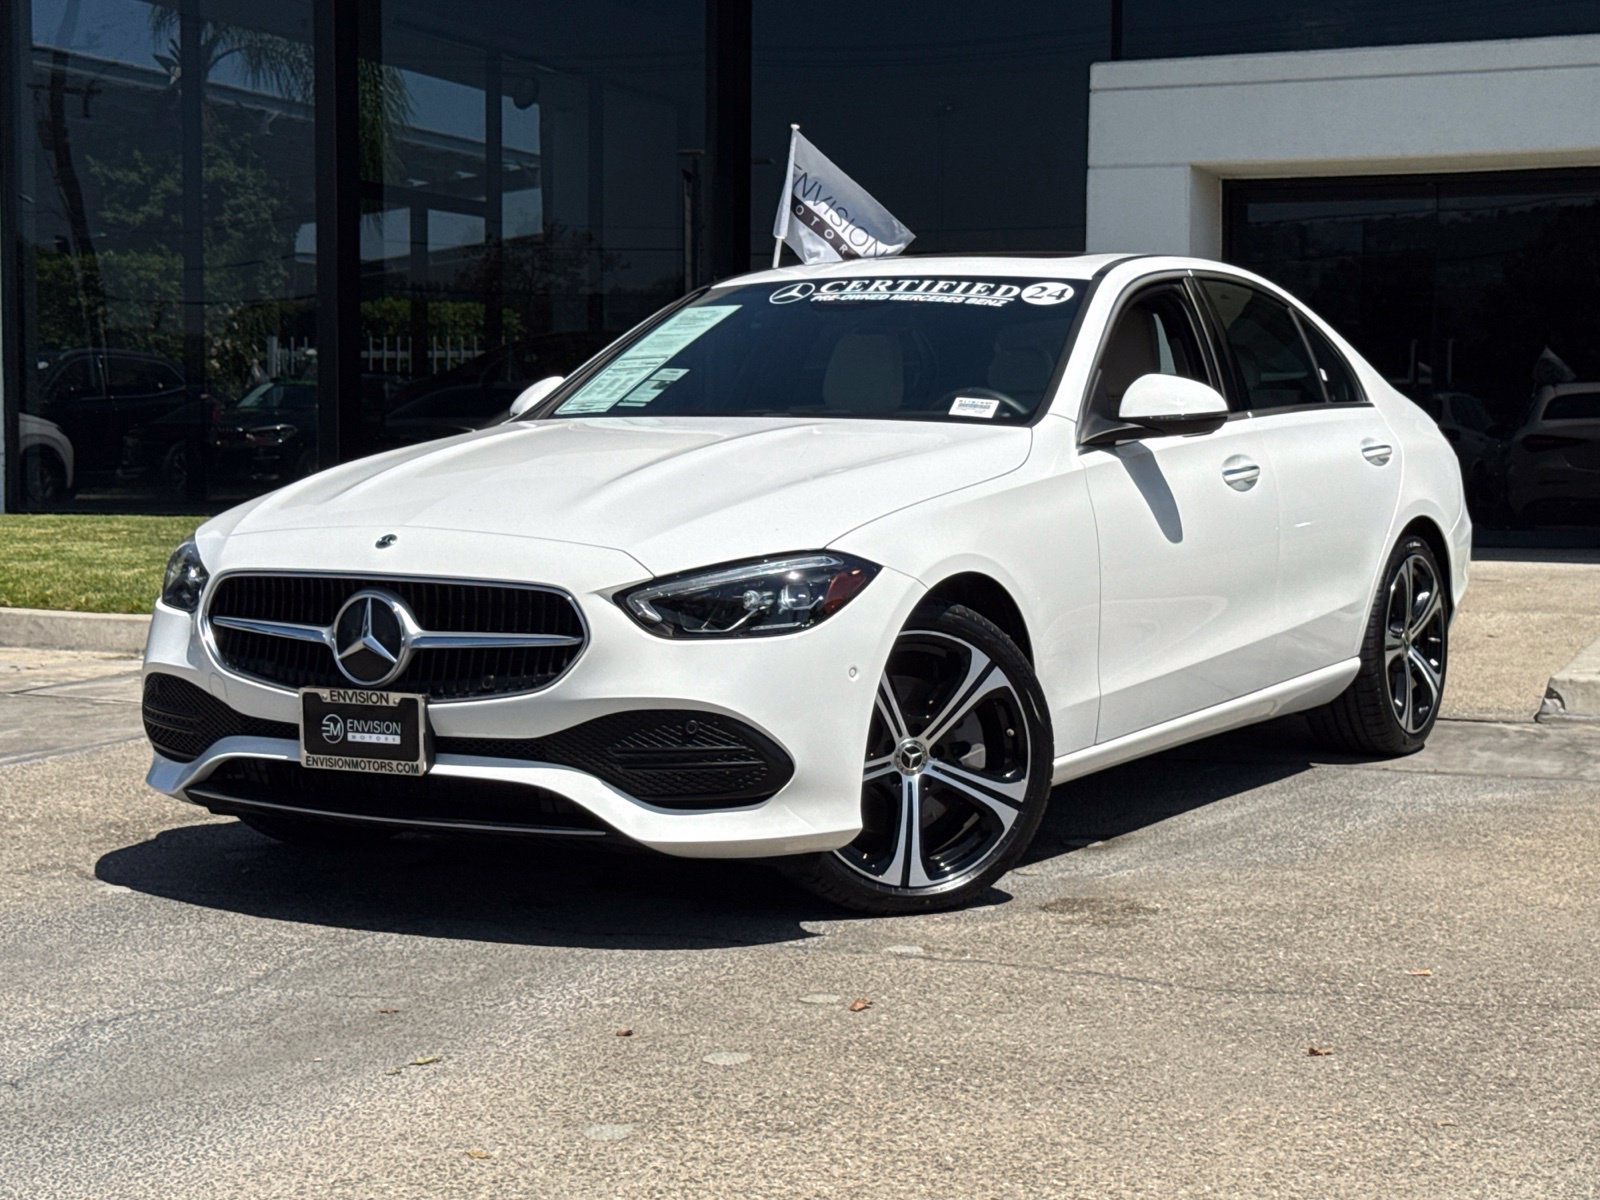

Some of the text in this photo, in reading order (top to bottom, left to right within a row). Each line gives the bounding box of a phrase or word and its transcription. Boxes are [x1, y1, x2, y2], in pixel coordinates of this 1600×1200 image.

[795, 204, 849, 255] OTOR
[820, 280, 1069, 300] CERTIFIED 24
[810, 294, 1008, 307] PRE-OWNED MERCEDES BENZ
[329, 689, 390, 705] ENVISION
[347, 719, 402, 735] ENVISION
[351, 734, 396, 742] MOTORS
[305, 756, 420, 774] ENVISIONMOTORS.COM
